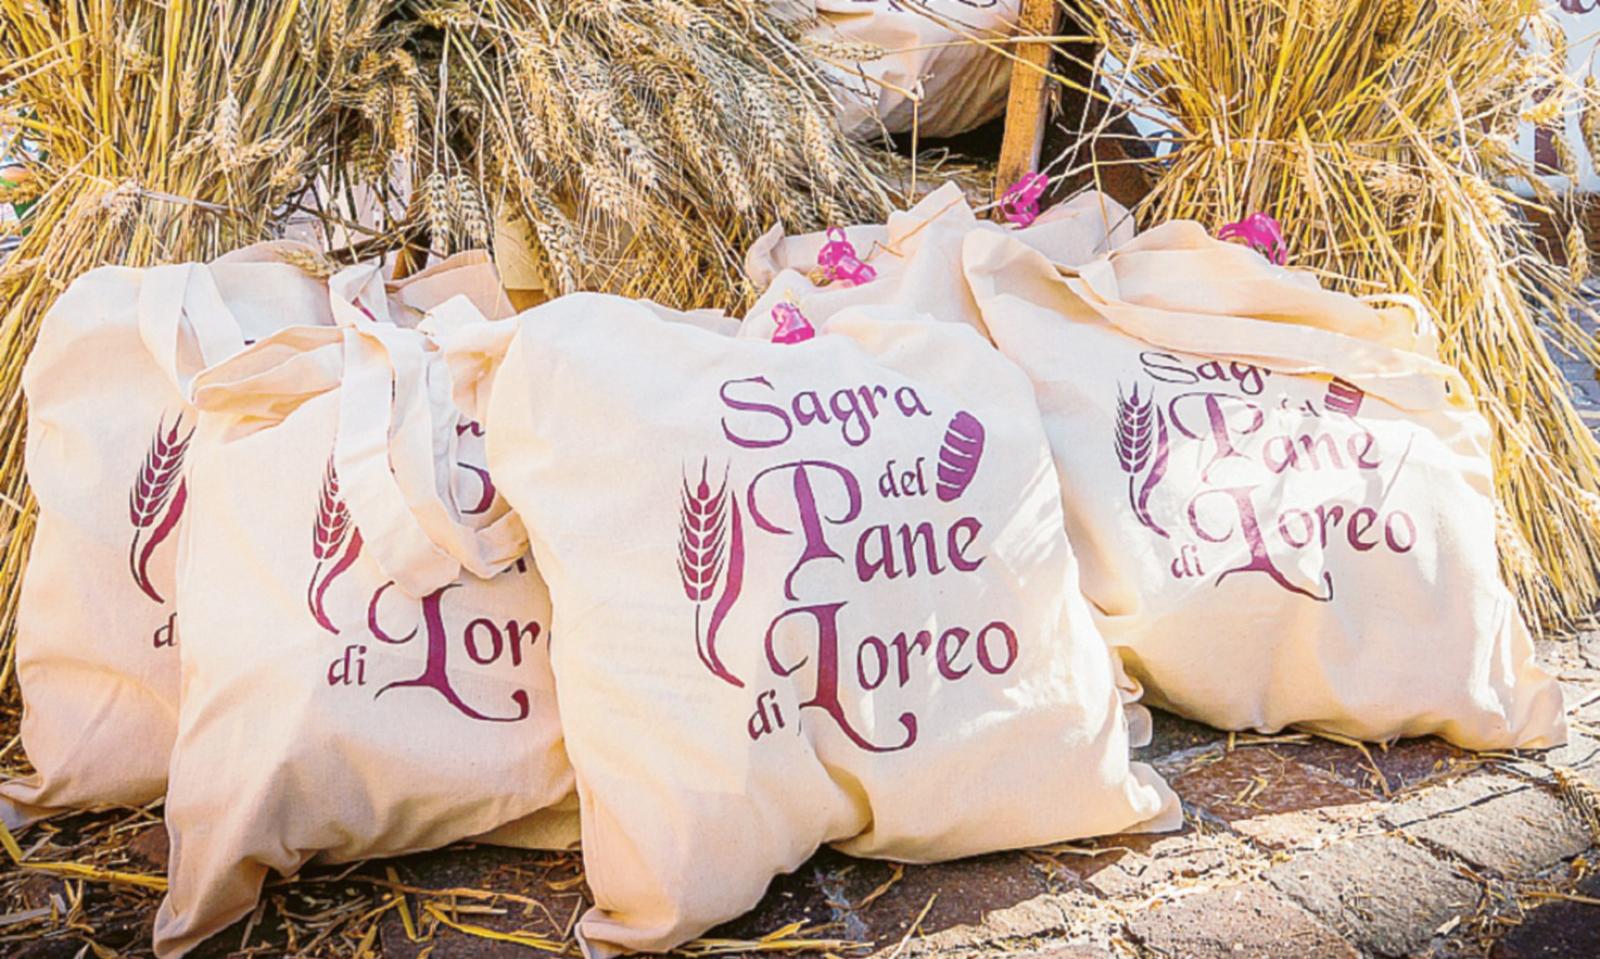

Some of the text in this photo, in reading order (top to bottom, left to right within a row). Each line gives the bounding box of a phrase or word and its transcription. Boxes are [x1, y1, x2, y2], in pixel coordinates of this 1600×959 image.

[720, 376, 932, 448] Sagra
[1140, 352, 1271, 395] Sag
[878, 457, 928, 498] del
[1169, 391, 1382, 484] Pane
[747, 459, 987, 601] Pane
[1171, 484, 1417, 601] di Loreo
[153, 611, 178, 648] d
[327, 644, 366, 686] di
[367, 580, 548, 722] Lor
[748, 690, 785, 740] di
[765, 601, 1018, 753] Loreo
